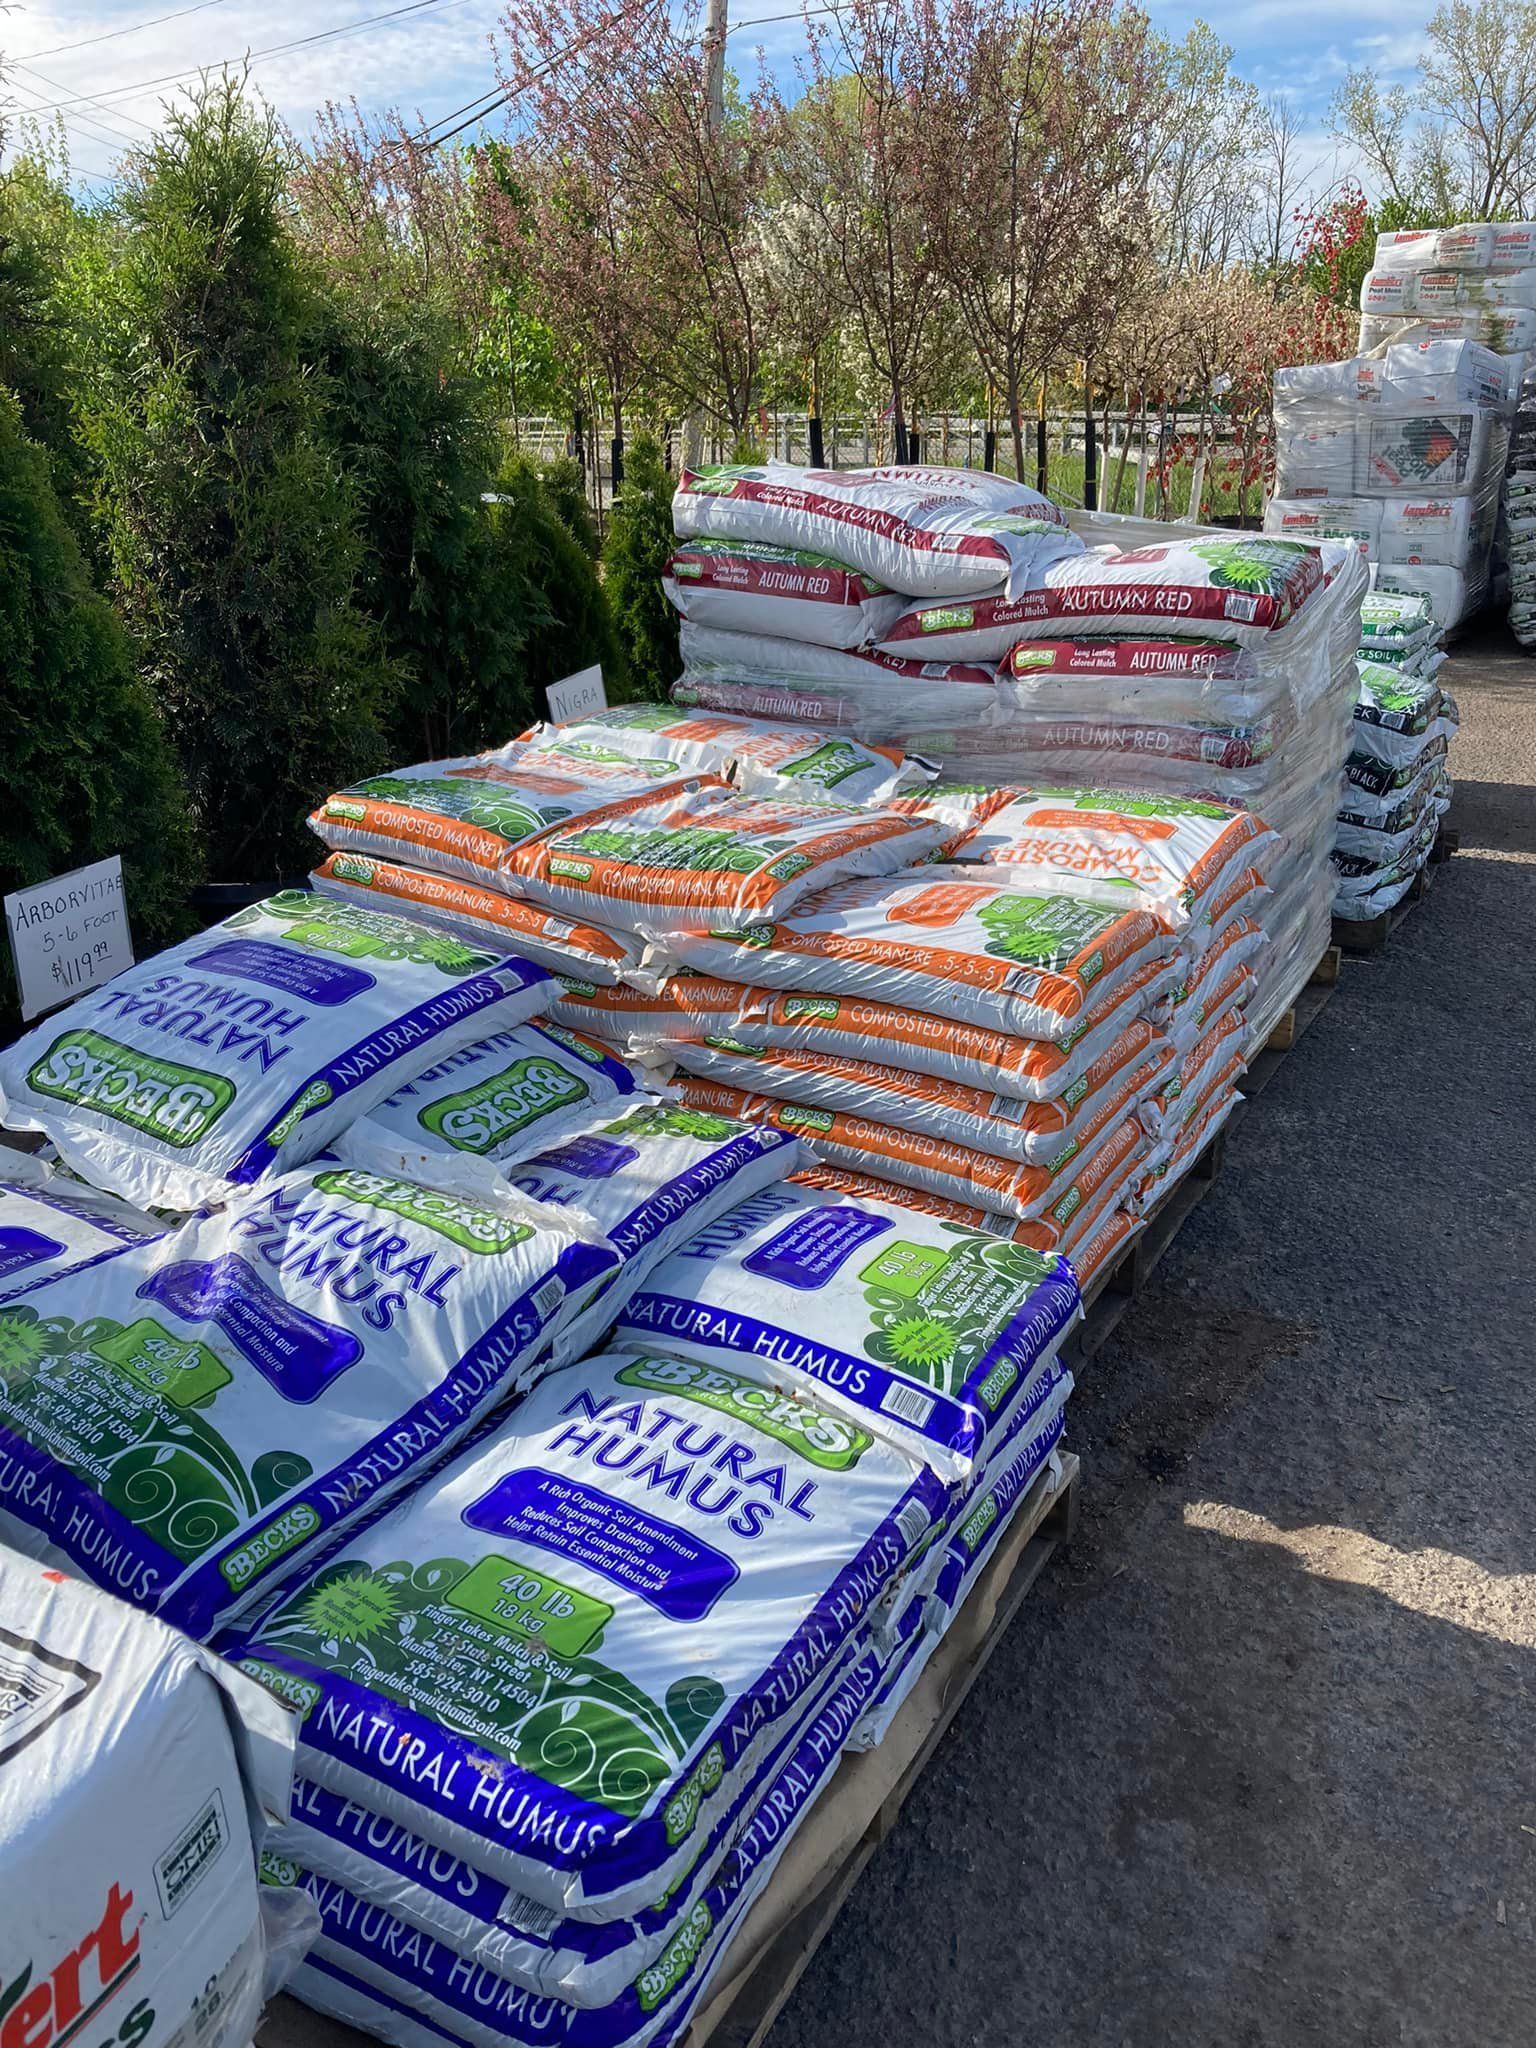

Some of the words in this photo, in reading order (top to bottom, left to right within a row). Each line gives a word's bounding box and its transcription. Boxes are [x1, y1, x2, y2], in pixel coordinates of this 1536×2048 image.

[815, 500, 892, 533] AUTUMN
[758, 570, 805, 593] AUTUMN
[806, 575, 830, 595] RED
[1062, 590, 1150, 612] AUTUMN
[1155, 590, 1192, 611] RED
[992, 608, 1022, 622] Colored
[1024, 605, 1049, 618] Mulch
[1070, 657, 1096, 668] Colored
[1097, 657, 1117, 668] Mulch
[1130, 652, 1187, 670] AUTUMN
[1192, 653, 1217, 672] RED
[556, 686, 598, 720] NIGRA
[752, 696, 797, 715] AUTUMN
[799, 700, 822, 717] RED
[1045, 727, 1123, 746] AUTUMN
[1134, 730, 1170, 749] RED
[1350, 768, 1378, 792] BLACK
[374, 809, 442, 839] COMPOSTED
[444, 827, 496, 859] MANURE
[378, 870, 444, 900] COMPOSTED
[444, 887, 494, 914] MANURE
[551, 858, 593, 879] BECKS
[16, 874, 123, 932] ARBORVITAE
[83, 909, 120, 933] FOOT
[782, 935, 867, 953] COMPOSTED
[870, 943, 933, 966] MANURE
[142, 976, 310, 1037] HUMUS
[682, 986, 735, 1002] MANURE
[99, 991, 293, 1074] NATURAL
[333, 1021, 428, 1085] NATURAL
[432, 982, 495, 1027] HUMUS
[851, 1005, 942, 1039] COMPOSTED
[946, 1024, 1014, 1057] MANURE
[36, 1045, 216, 1134] BECKS
[775, 1046, 859, 1074] COMPOSTED
[859, 1064, 922, 1090] MANURE
[442, 1066, 577, 1148] BECKS
[683, 1088, 735, 1109] MANURE
[783, 1109, 836, 1130] BECKS
[844, 1118, 938, 1155] COMPOSTED
[942, 1147, 1004, 1178] MANURE
[616, 1183, 700, 1256] NATURAL
[699, 1145, 754, 1187] HUMUS
[857, 1177, 916, 1203] MANURE
[254, 1185, 461, 1309] NATURAL
[677, 1191, 798, 1262] HUMUS
[230, 1211, 407, 1332] HUMUS
[877, 1259, 905, 1277] 40
[143, 1337, 176, 1362] 40
[175, 1347, 201, 1370] lb
[230, 1296, 277, 1343] Compaction
[274, 1336, 300, 1356] and
[246, 1334, 285, 1373] Moisture
[622, 1300, 742, 1347] NATURAL
[753, 1334, 871, 1395] HUMUS
[65, 1368, 88, 1386] 155
[147, 1363, 169, 1386] kg
[983, 1357, 1017, 1403] BECKS
[1012, 1307, 1059, 1370] NATURAL
[84, 1402, 108, 1420] NY
[153, 1402, 181, 1427] Soil
[646, 1357, 855, 1455] BECKS
[683, 1385, 735, 1410] GARDEN
[226, 1506, 319, 1583] BECKS
[321, 1409, 450, 1514] NATURAL
[442, 1311, 536, 1416] HUMUS
[558, 1387, 821, 1523] NATURAL
[544, 1424, 776, 1540] HUMUS
[963, 1499, 997, 1546] BECKS
[993, 1440, 1042, 1509] NATURAL
[520, 1503, 562, 1531] Reduces
[561, 1519, 585, 1540] Soil
[583, 1529, 646, 1571] Compaction
[645, 1556, 672, 1582] and
[538, 1480, 550, 1493] A
[548, 1482, 570, 1502] Rich
[570, 1490, 612, 1518] Organic
[611, 1504, 633, 1526] Soil
[632, 1516, 700, 1564] Amendment
[556, 1500, 605, 1532] Improves
[606, 1522, 656, 1557] Drainage
[62, 1504, 160, 1600] HUMUS
[502, 1514, 533, 1537] Helps
[532, 1526, 568, 1550] Retain
[567, 1536, 617, 1571] Essential
[615, 1560, 666, 1594] Moisture
[492, 1598, 518, 1622] 18
[517, 1610, 547, 1635] kg
[496, 1571, 543, 1603] 40
[540, 1588, 577, 1620] lb
[420, 1603, 453, 1631] Finger
[453, 1619, 495, 1648] Lakes
[494, 1634, 532, 1665] Mulch
[529, 1651, 547, 1670] &
[544, 1656, 575, 1683] Soil
[432, 1628, 455, 1648] 155
[454, 1637, 491, 1665] State
[489, 1654, 533, 1685] Street
[730, 1636, 838, 1756] NATURAL
[829, 1537, 903, 1634] HUMUS
[396, 1634, 468, 1676] Manchester,
[468, 1667, 496, 1688] NY
[493, 1678, 540, 1711] 14504
[403, 1660, 502, 1714] 585-924-3010
[350, 1656, 523, 1753] Fingerlakesmulchandsoil.com
[318, 1695, 456, 1800] NATURAL
[474, 1774, 607, 1861] HUMUS
[166, 1815, 224, 1892] OMRI
[335, 1801, 482, 1898] HUMUS
[640, 1900, 713, 2001] BECKS
[812, 1662, 878, 1766] HUMUS
[303, 1873, 436, 1976] NATURAL
